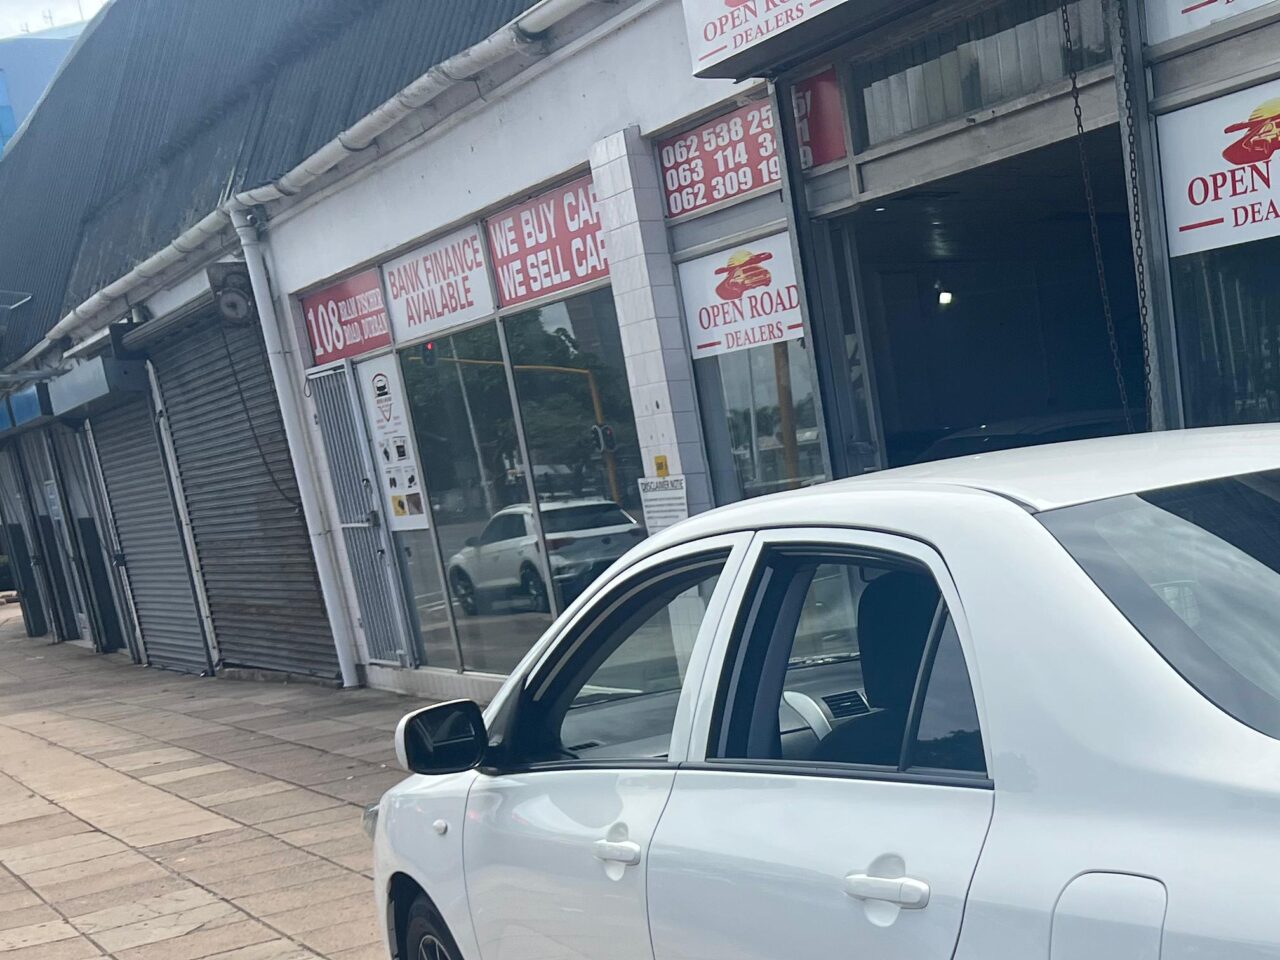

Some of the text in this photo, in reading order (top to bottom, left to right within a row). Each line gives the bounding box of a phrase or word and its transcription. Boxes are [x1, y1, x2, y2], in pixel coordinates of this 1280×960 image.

[703, 1, 757, 42] OPEN
[732, 3, 804, 49] DEALERS
[662, 135, 699, 168] 062
[702, 117, 744, 151] 538
[665, 133, 776, 191] 063 114 3
[669, 183, 707, 214] 062
[711, 167, 753, 199] 309
[1187, 159, 1271, 206] OPEN
[489, 217, 519, 259] WE
[520, 200, 556, 248] BUY
[388, 234, 483, 300] BANK FINANCE
[498, 259, 526, 300] WE
[526, 245, 571, 292] SELL
[406, 274, 474, 327] AVAILABLE
[699, 284, 801, 330] OPEN ROAD
[308, 300, 344, 356] 108
[725, 321, 784, 349] DEALERS
